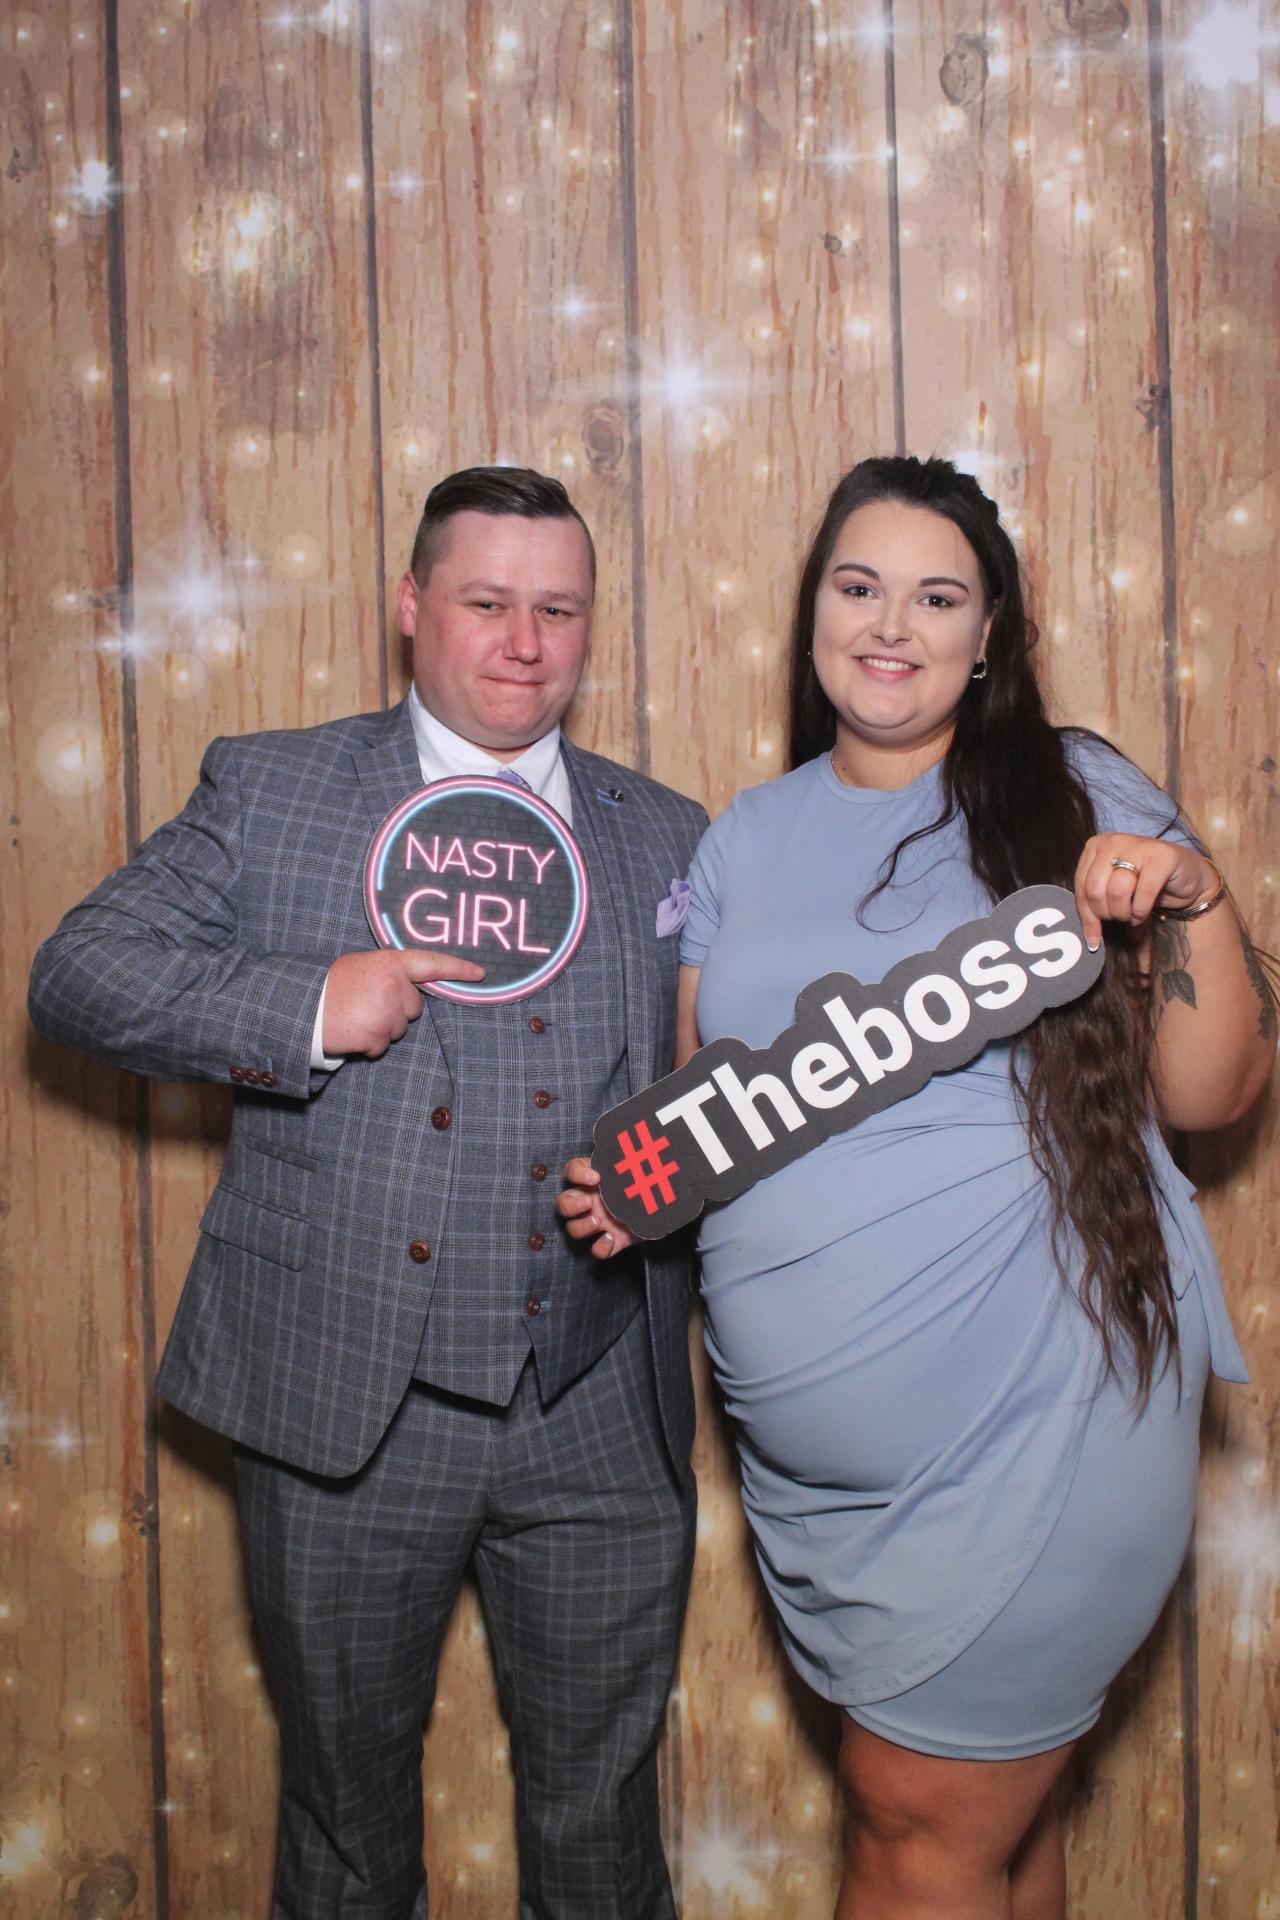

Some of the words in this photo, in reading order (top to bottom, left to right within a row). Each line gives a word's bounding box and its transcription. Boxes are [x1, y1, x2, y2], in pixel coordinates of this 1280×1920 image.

[406, 833, 555, 884] NASTY
[403, 888, 551, 953] GIRL
[614, 907, 1083, 1216] #Theboss
